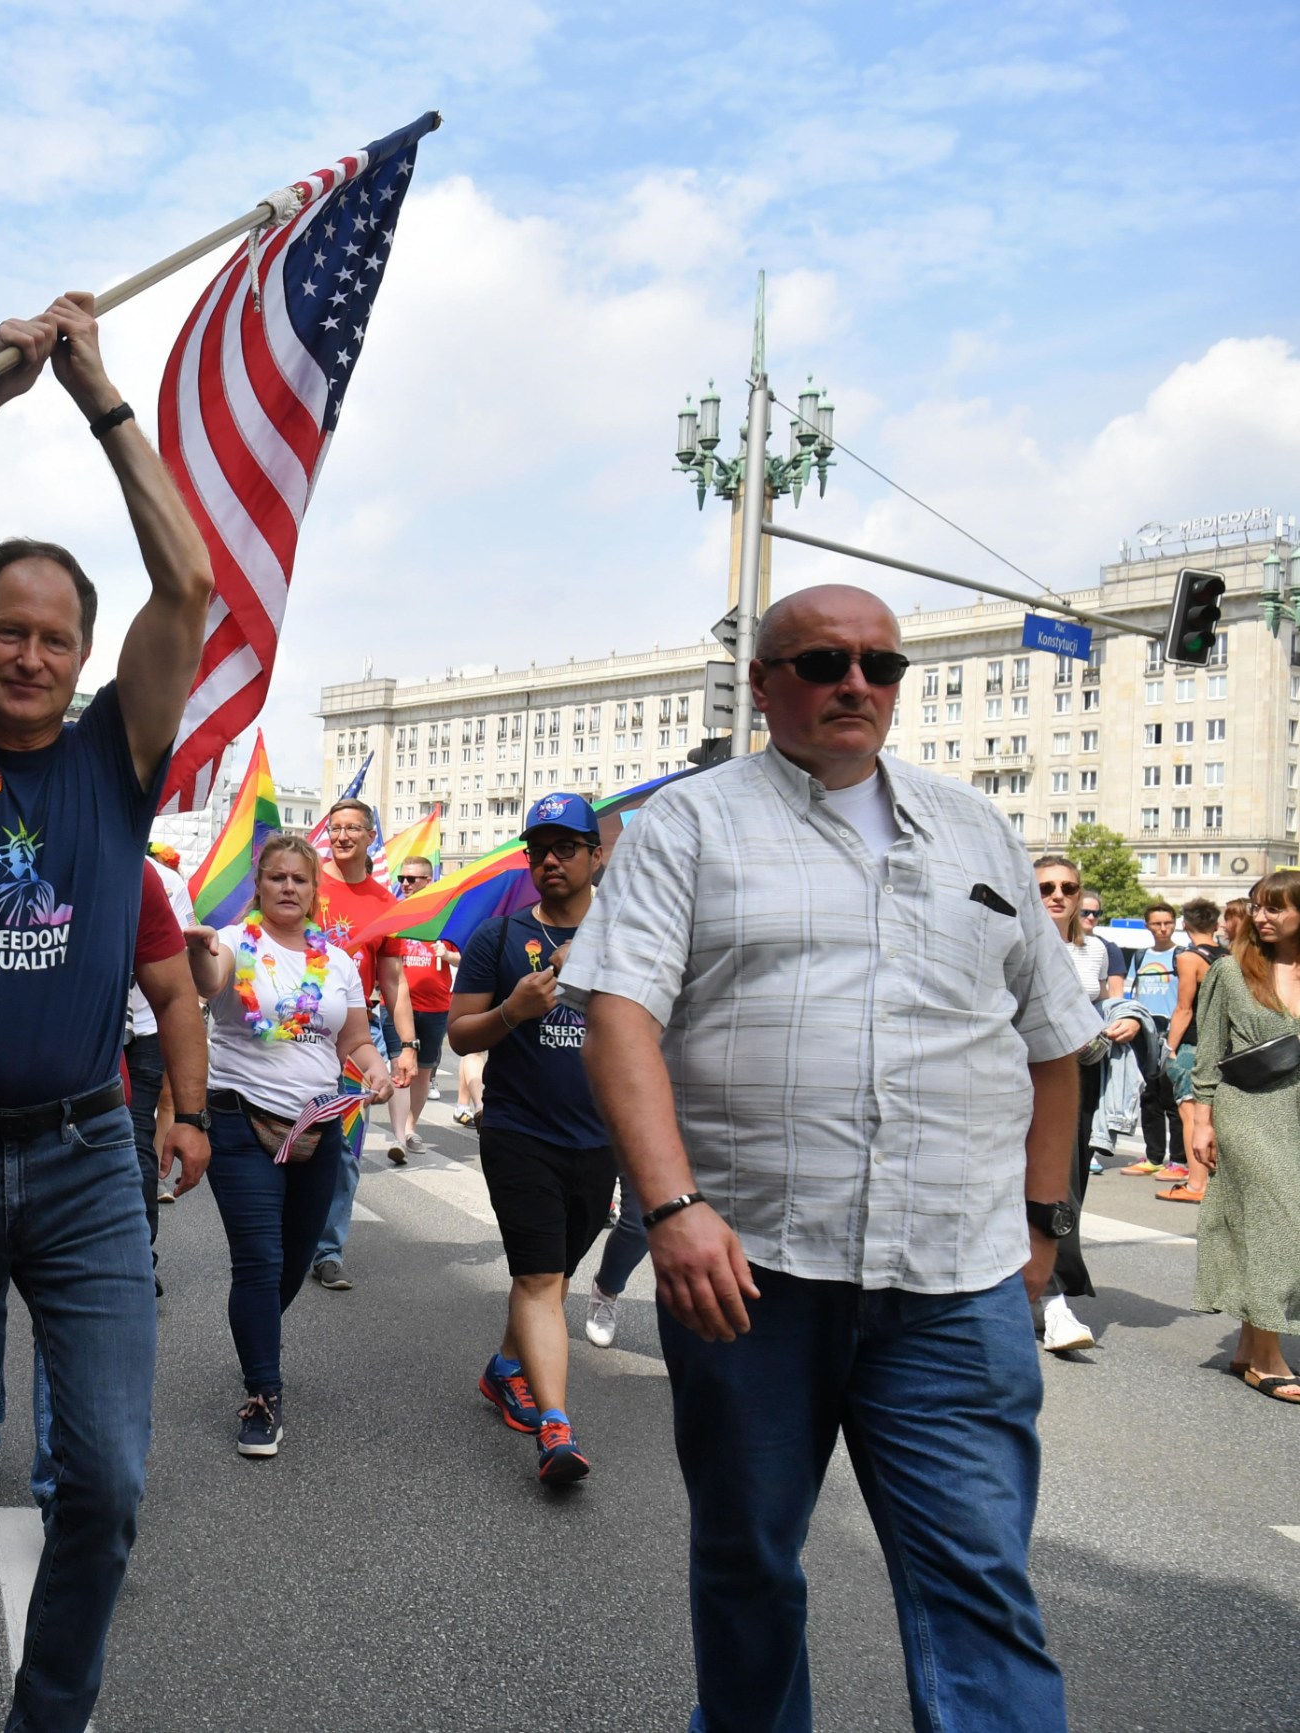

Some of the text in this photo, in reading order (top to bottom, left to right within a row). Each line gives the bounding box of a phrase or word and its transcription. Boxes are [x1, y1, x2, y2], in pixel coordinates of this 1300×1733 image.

[1179, 506, 1273, 532] MEDICOVER
[1054, 621, 1067, 634] Plac
[1037, 631, 1079, 656] Konstytucji
[540, 1024, 587, 1037] FREEDO
